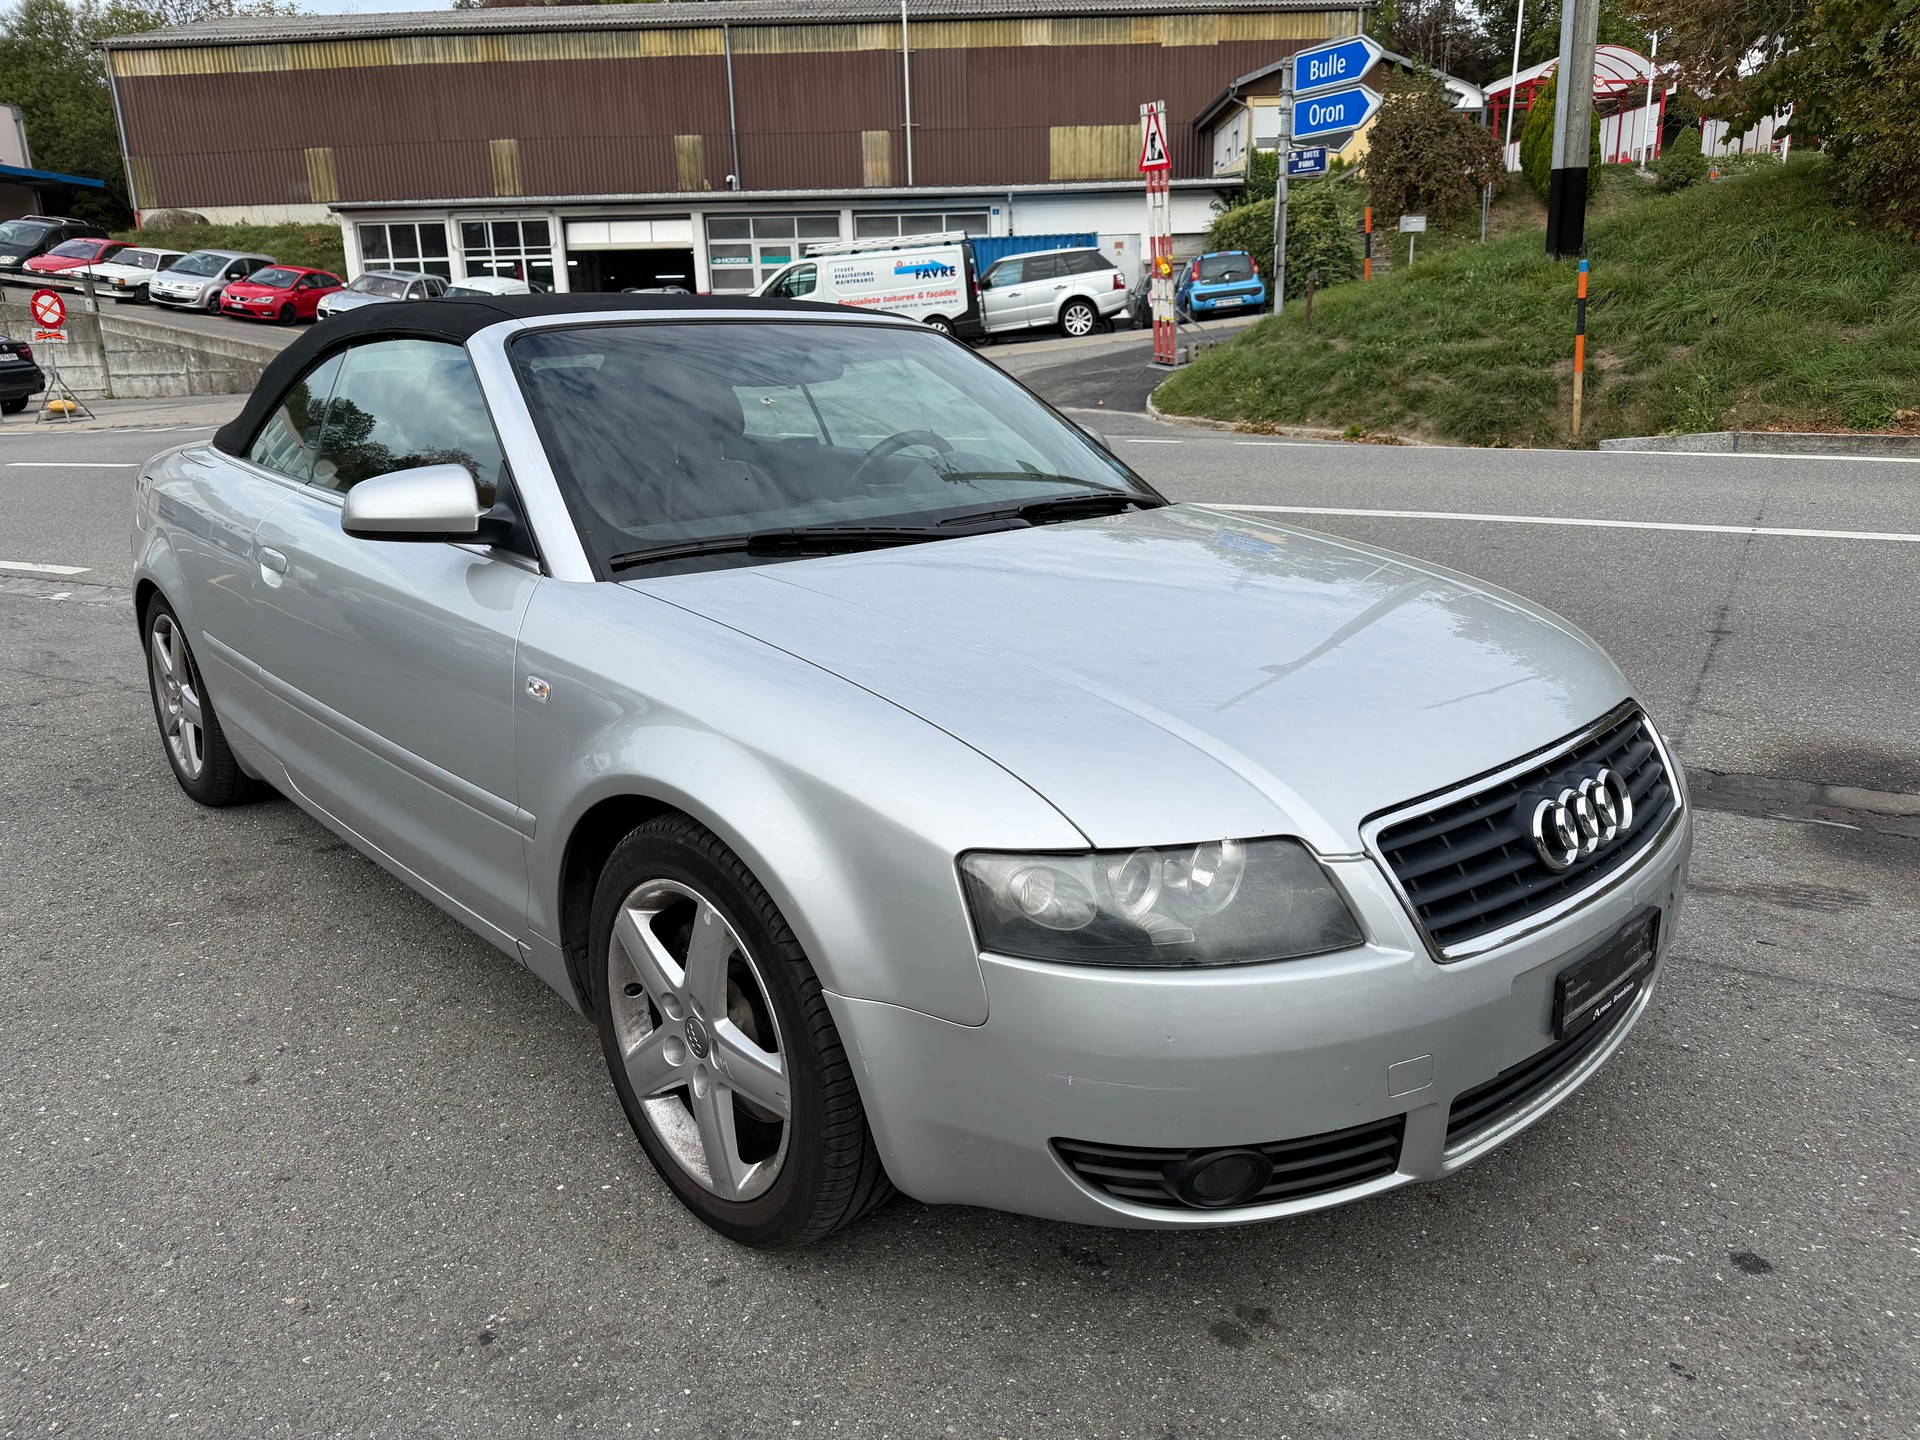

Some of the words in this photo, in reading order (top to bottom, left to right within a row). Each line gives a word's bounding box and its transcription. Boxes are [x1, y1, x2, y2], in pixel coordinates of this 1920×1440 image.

[1309, 53, 1346, 80] Bulle
[1309, 104, 1344, 126] Oron
[915, 266, 956, 280] FAVRE
[883, 293, 915, 303] toitures
